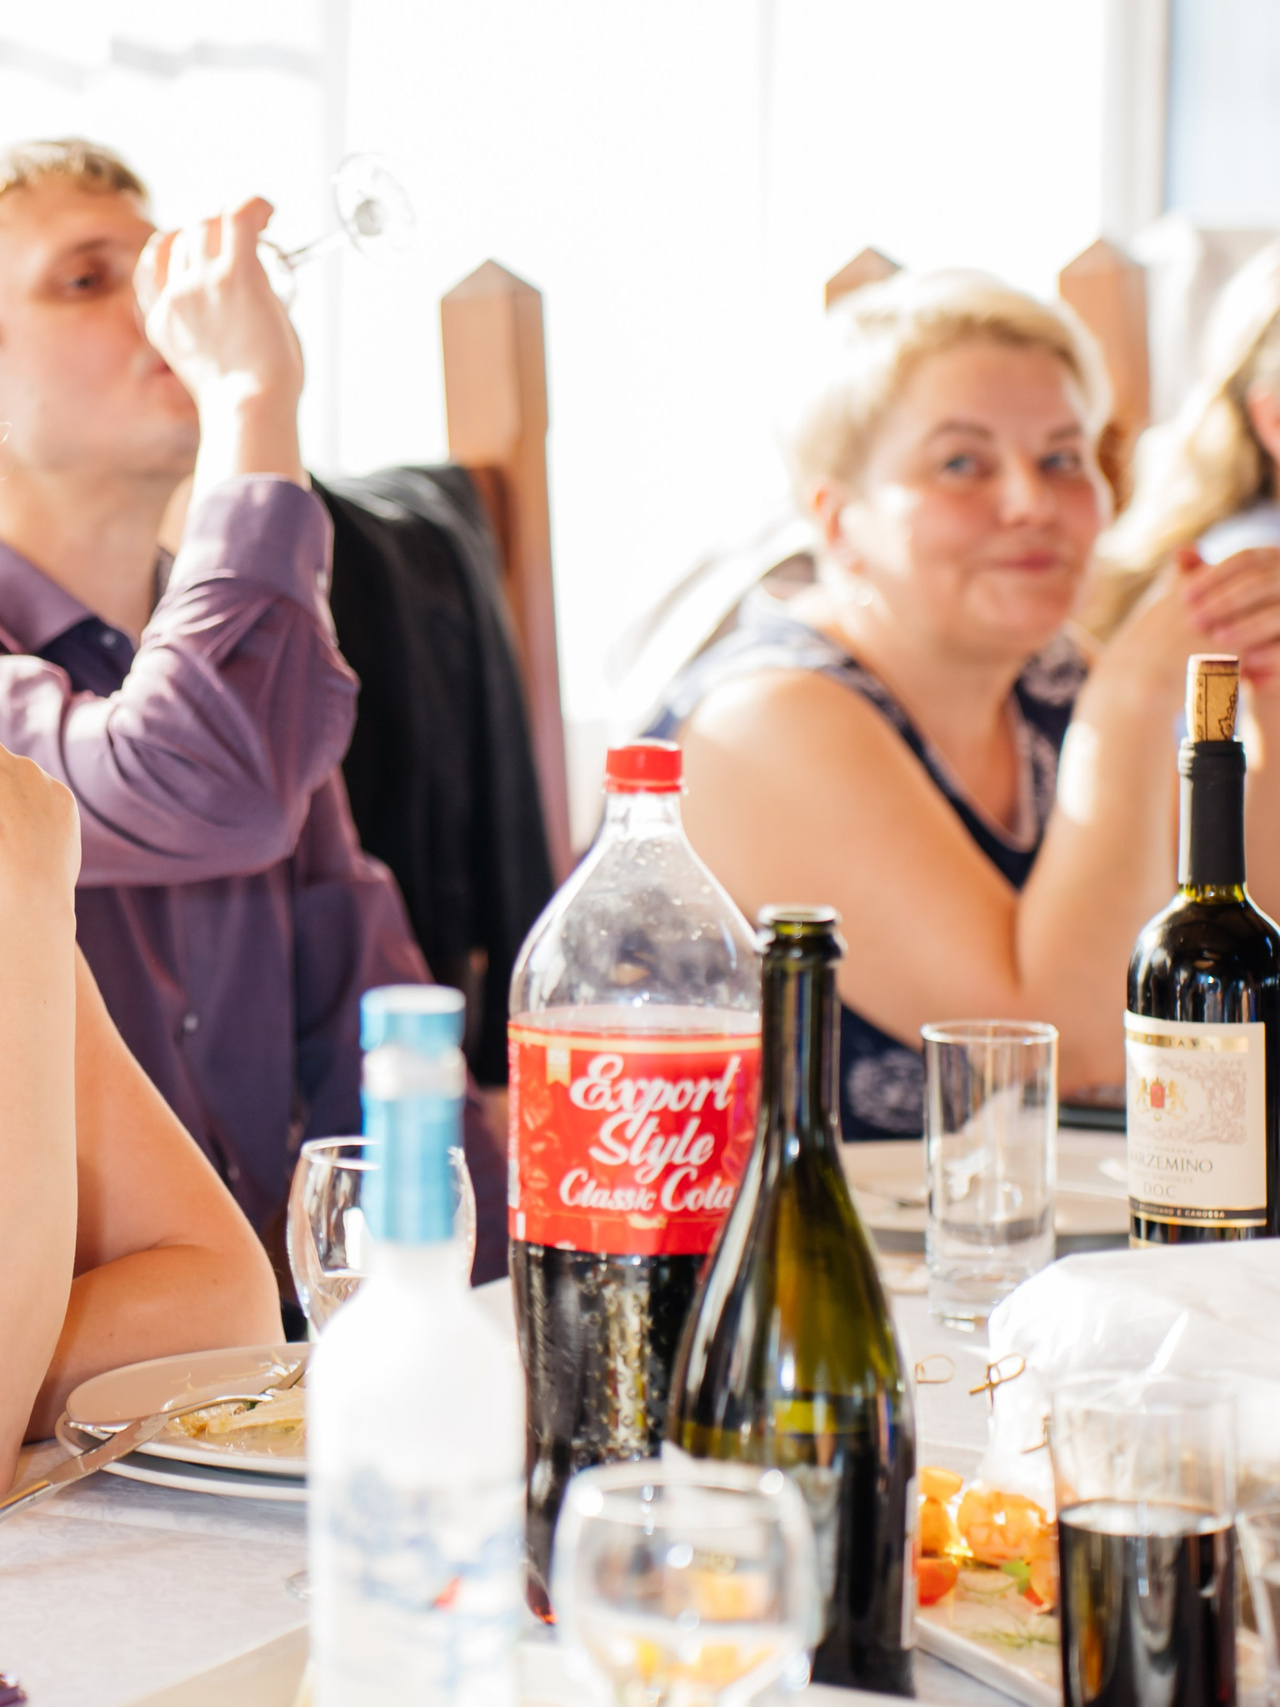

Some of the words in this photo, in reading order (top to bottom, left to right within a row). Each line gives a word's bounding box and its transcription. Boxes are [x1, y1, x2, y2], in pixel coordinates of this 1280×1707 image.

[569, 1053, 741, 1140] Export
[588, 1112, 716, 1185] Style
[559, 1168, 656, 1212] Classic
[660, 1166, 735, 1213] Cola
